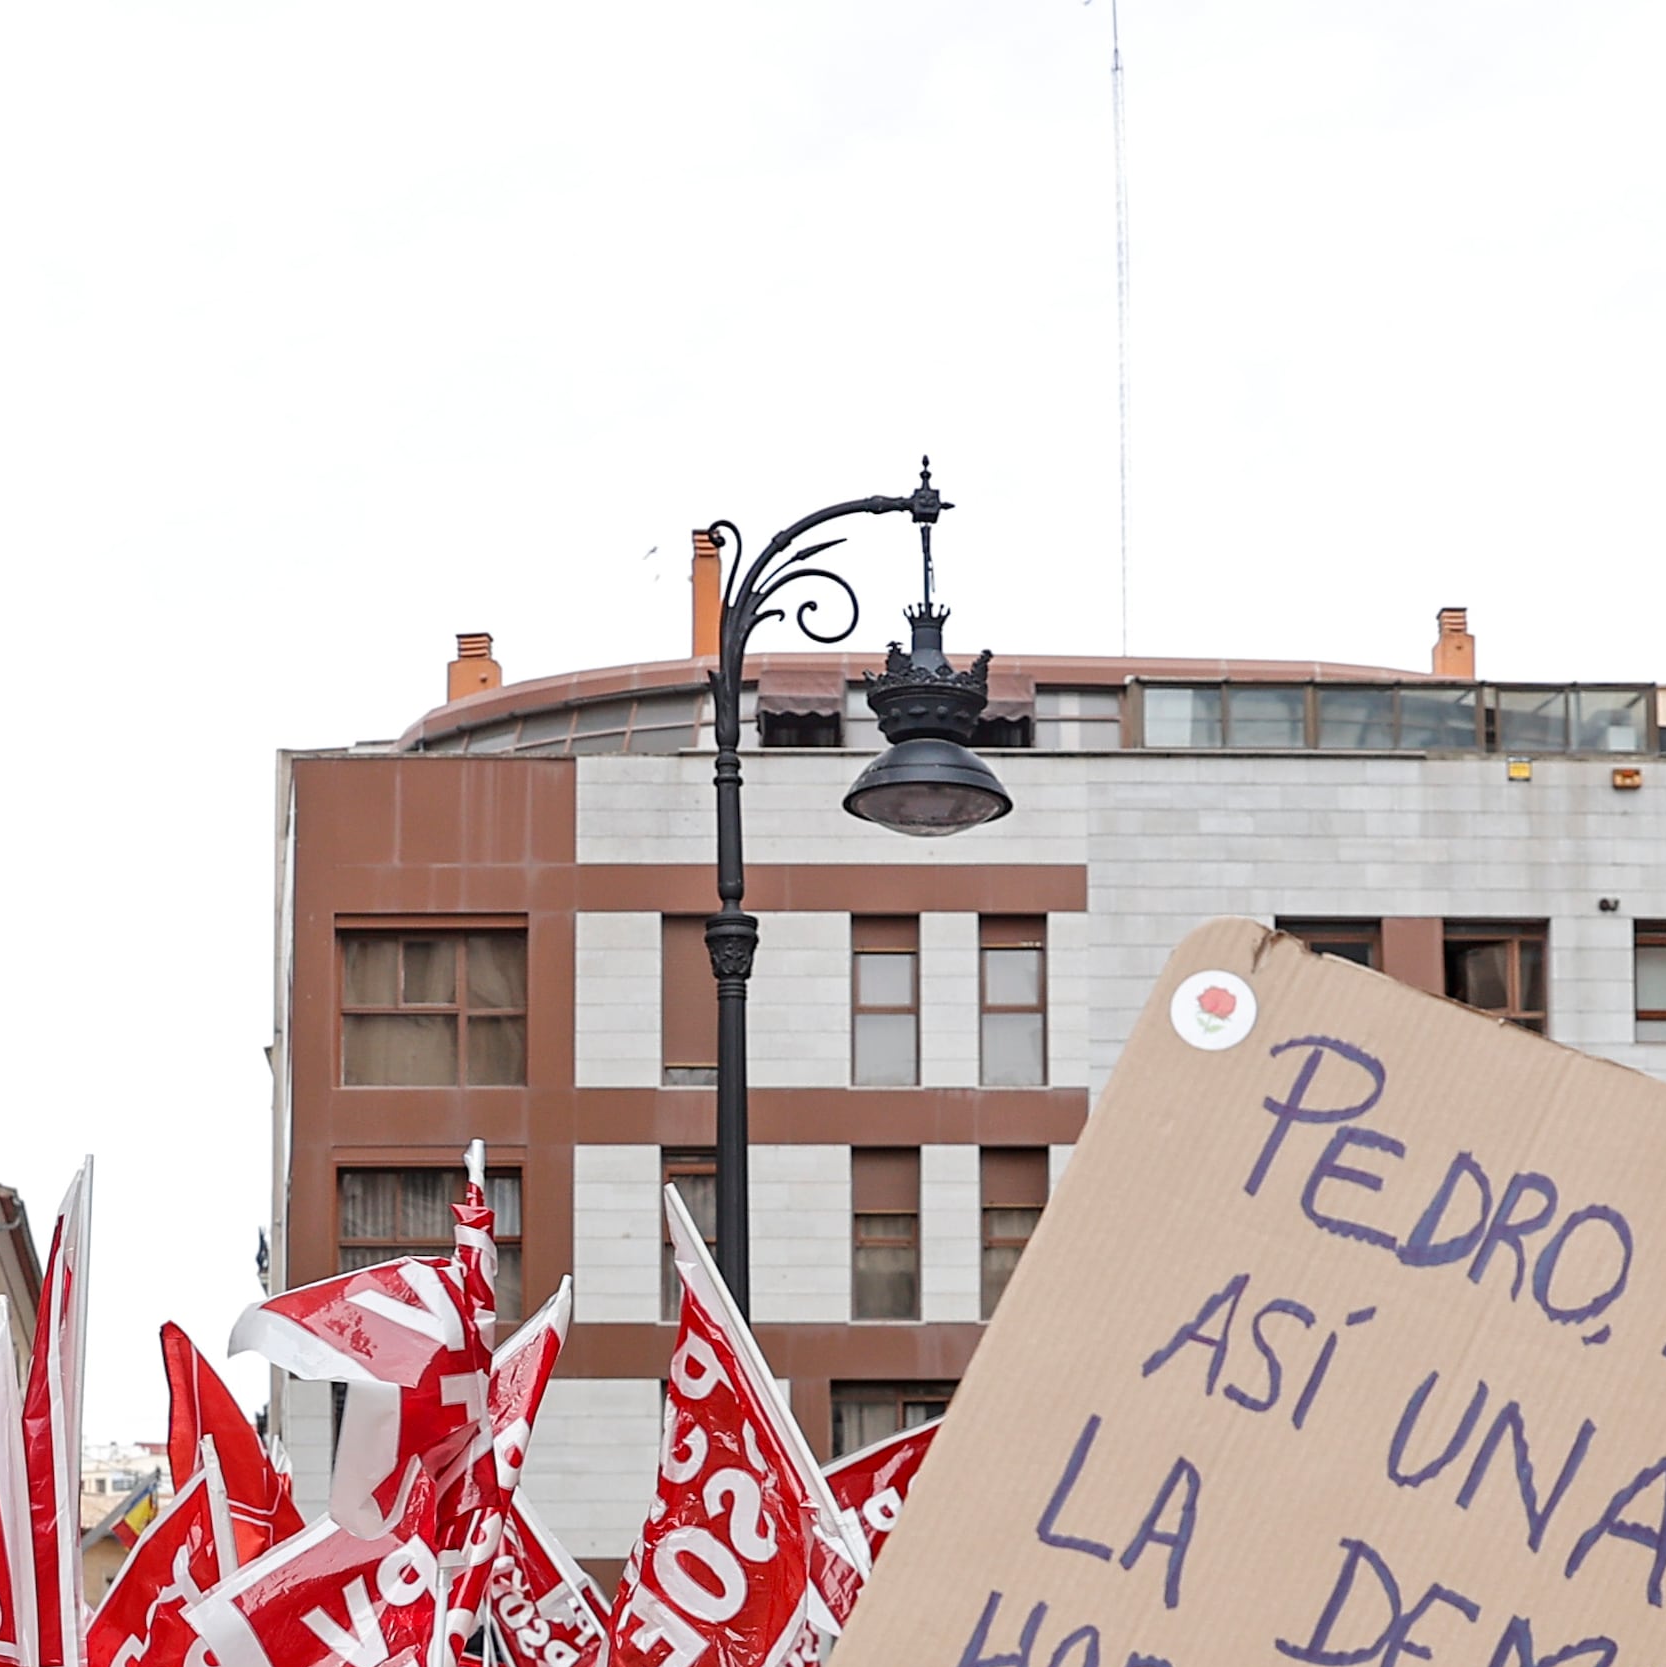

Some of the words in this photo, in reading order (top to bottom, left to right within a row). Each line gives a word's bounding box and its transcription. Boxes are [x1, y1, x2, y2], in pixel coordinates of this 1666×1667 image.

[1243, 1035, 1634, 1346] PEDRO,
[1141, 1272, 1377, 1429] ASÍ
[1037, 1414, 1203, 1610] LA
